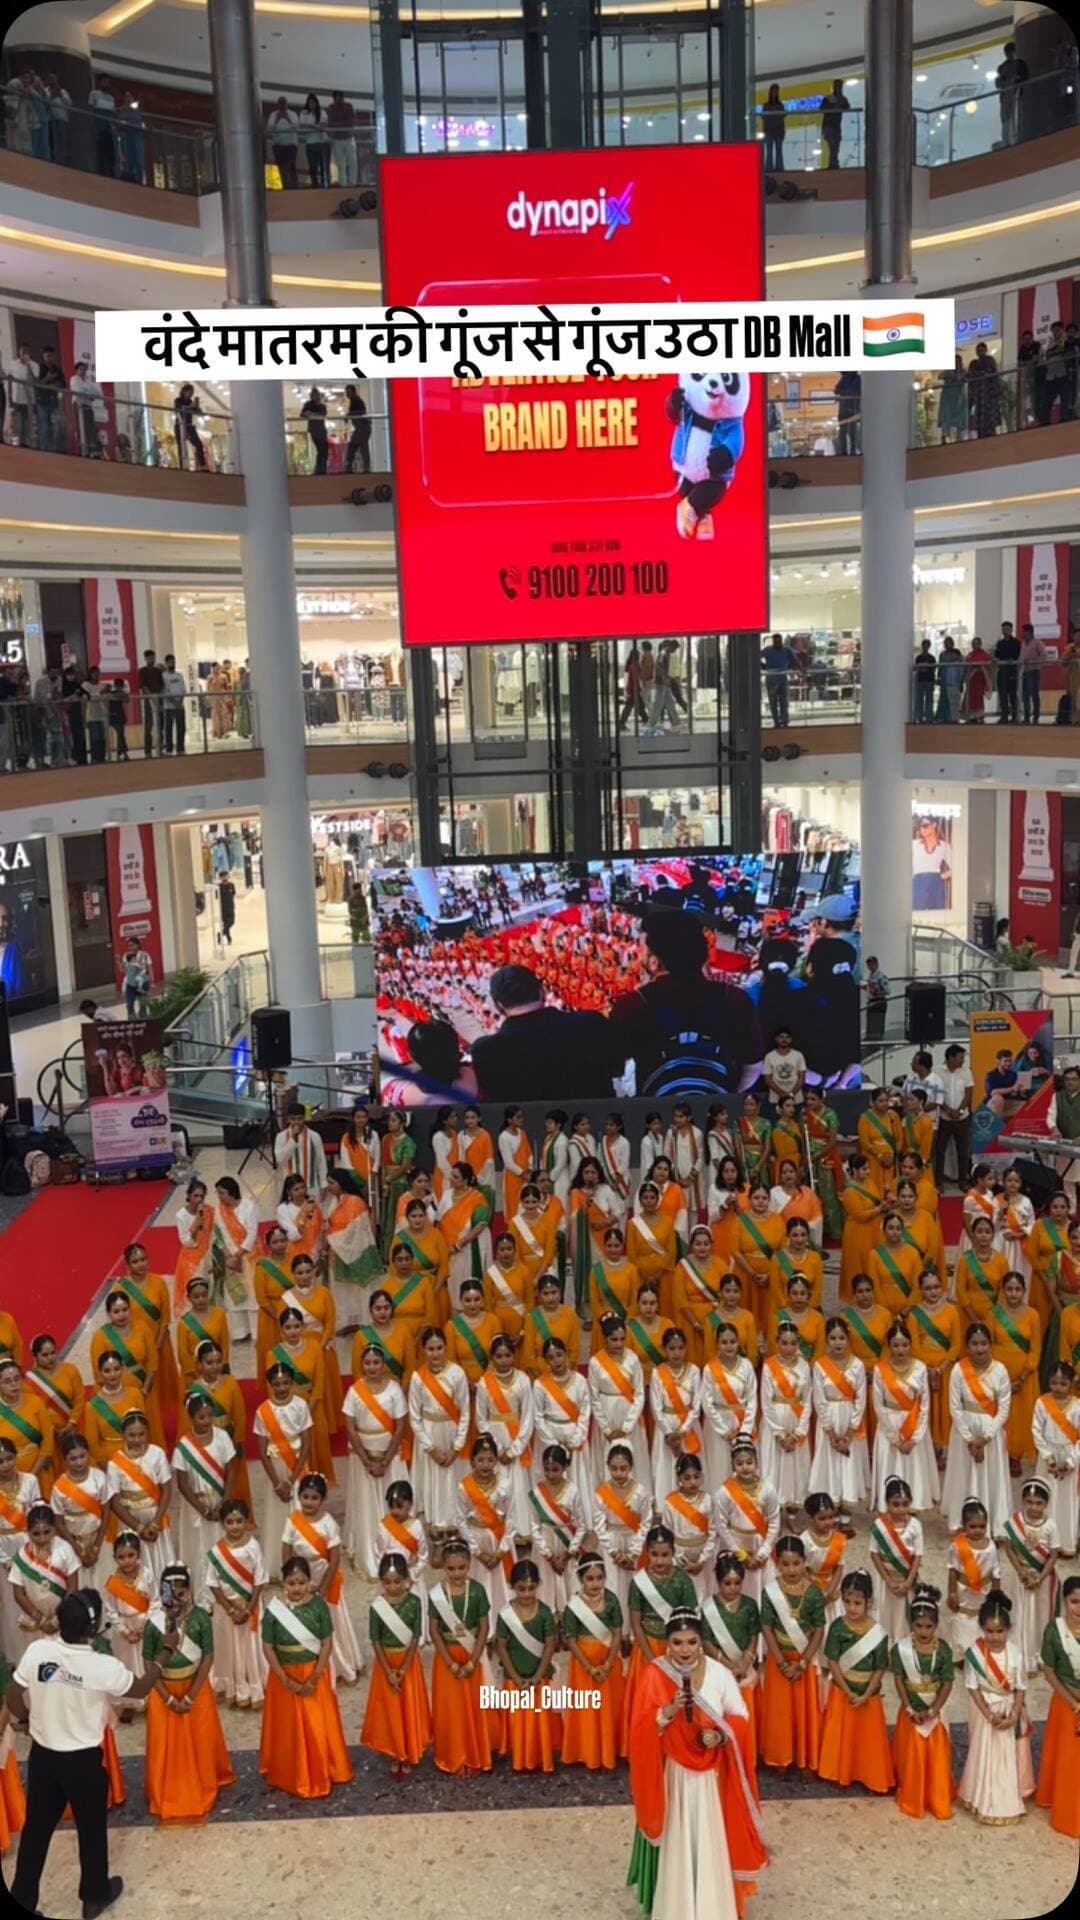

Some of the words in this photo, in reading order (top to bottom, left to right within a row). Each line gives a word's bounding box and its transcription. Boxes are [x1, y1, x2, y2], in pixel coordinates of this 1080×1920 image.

[506, 181, 634, 240] dynapix
[483, 400, 569, 453] BRAND
[575, 397, 639, 448] HERE
[528, 565, 580, 600] 9100
[585, 563, 626, 597] 200
[631, 560, 668, 595] 100
